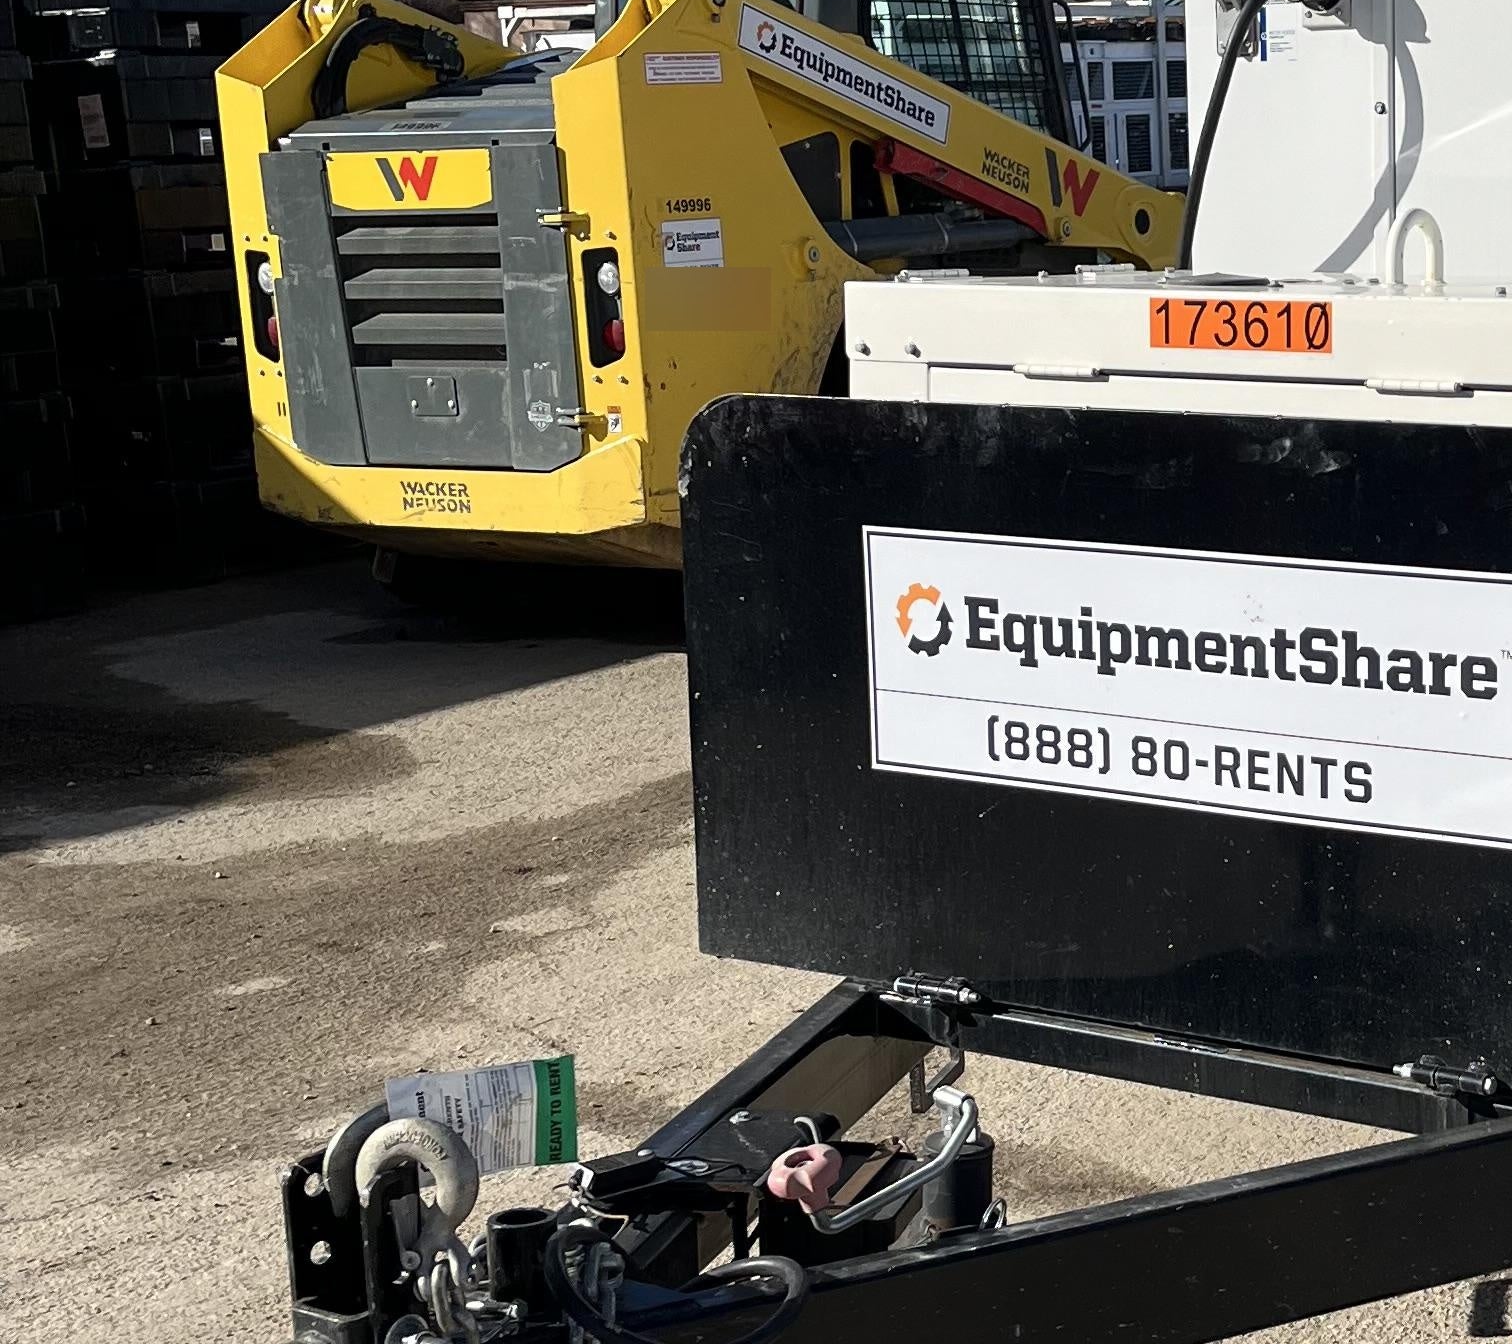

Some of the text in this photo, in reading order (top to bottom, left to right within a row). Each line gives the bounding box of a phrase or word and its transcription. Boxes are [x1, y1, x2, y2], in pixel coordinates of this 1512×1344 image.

[780, 33, 936, 128] EquipmentShare
[982, 161, 1029, 194] NEUSON
[984, 146, 1029, 180] WACKER
[666, 198, 712, 214] 149996
[676, 230, 720, 243] Equipment
[677, 242, 701, 253] Share
[1156, 299, 1330, 351] 173610
[400, 480, 469, 497] WACKER
[402, 496, 471, 514] NEUSON
[963, 595, 1499, 701] EquipmentShare
[987, 714, 1373, 805] (888) 80-RENTS
[547, 1061, 562, 1163] READY TO RENT
